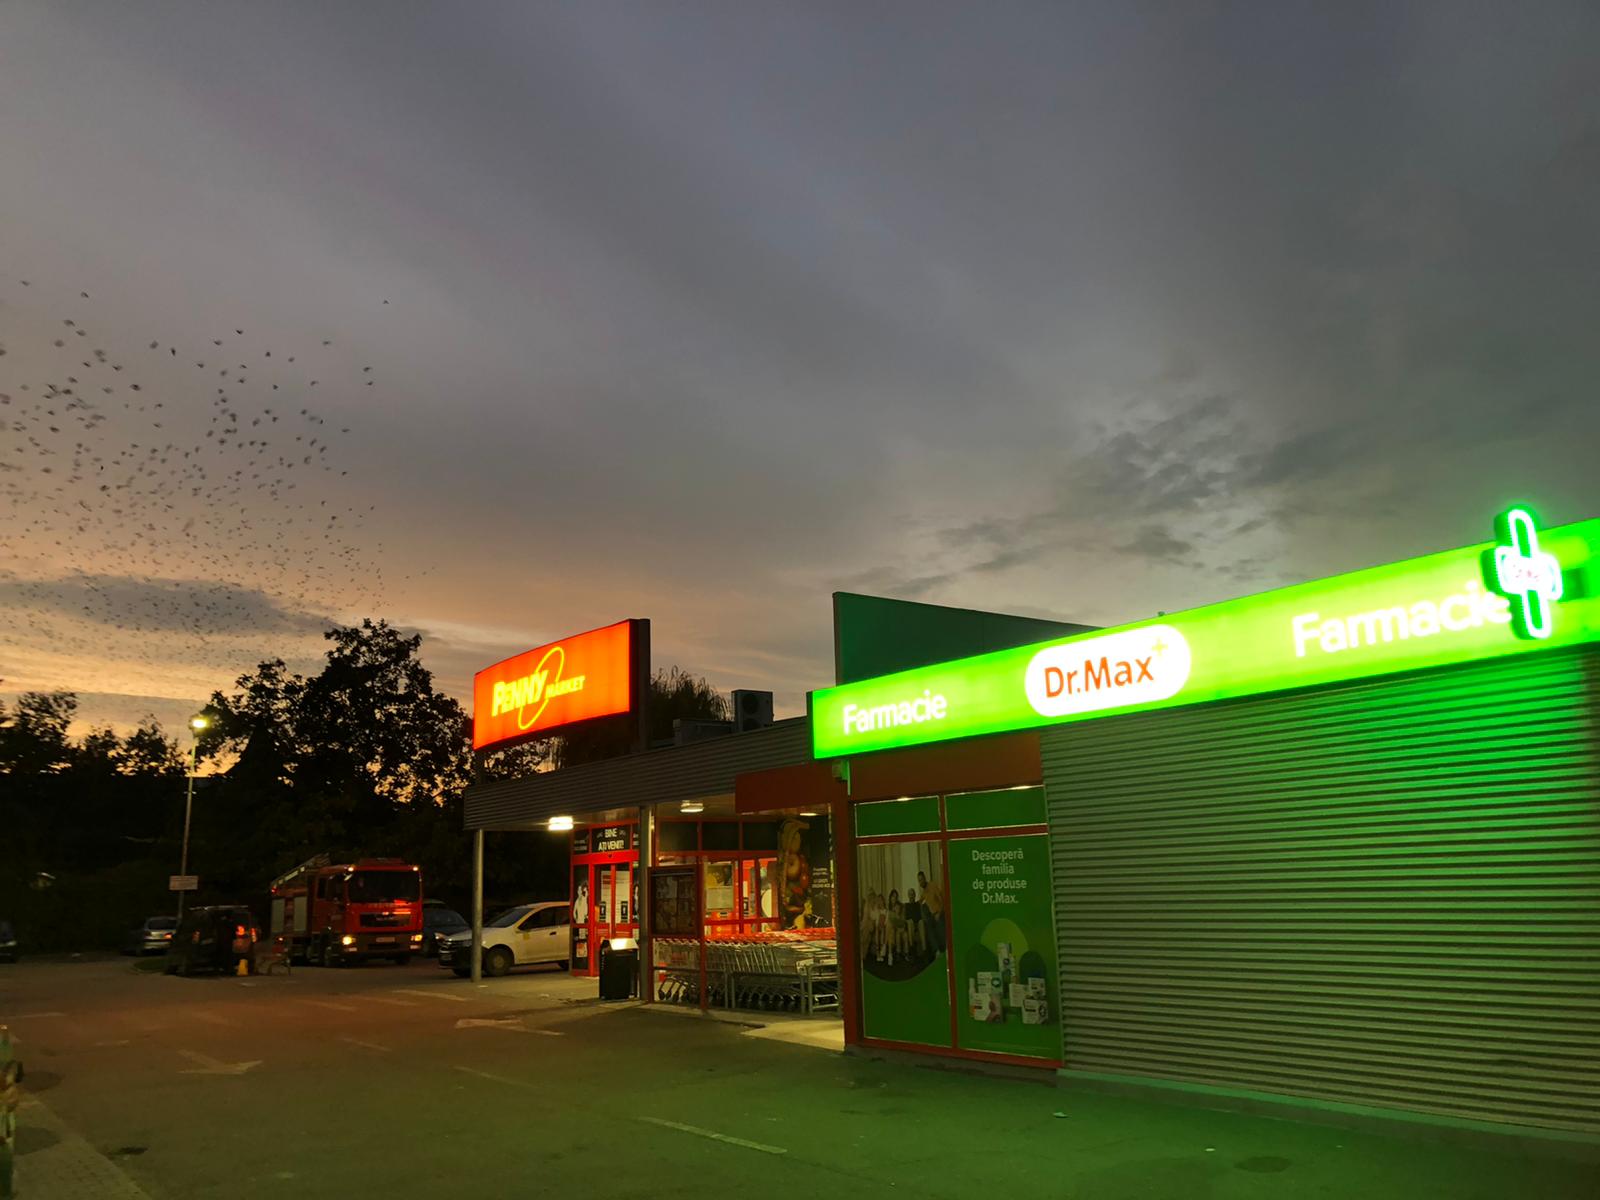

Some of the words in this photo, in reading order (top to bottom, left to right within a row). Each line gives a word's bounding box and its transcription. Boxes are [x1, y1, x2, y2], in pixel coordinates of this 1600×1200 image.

[1292, 580, 1513, 658] Farmacie
[1044, 656, 1155, 698] Dr.Max
[491, 669, 549, 717] PENNY
[545, 675, 586, 699] MARKET
[843, 689, 948, 735] Farmacie
[604, 828, 617, 838] BINE
[972, 848, 1024, 862] Descoperă
[982, 863, 1015, 875] familia
[972, 878, 985, 890] de
[987, 878, 1028, 892] produse
[982, 892, 1019, 904] Dr.Max.
